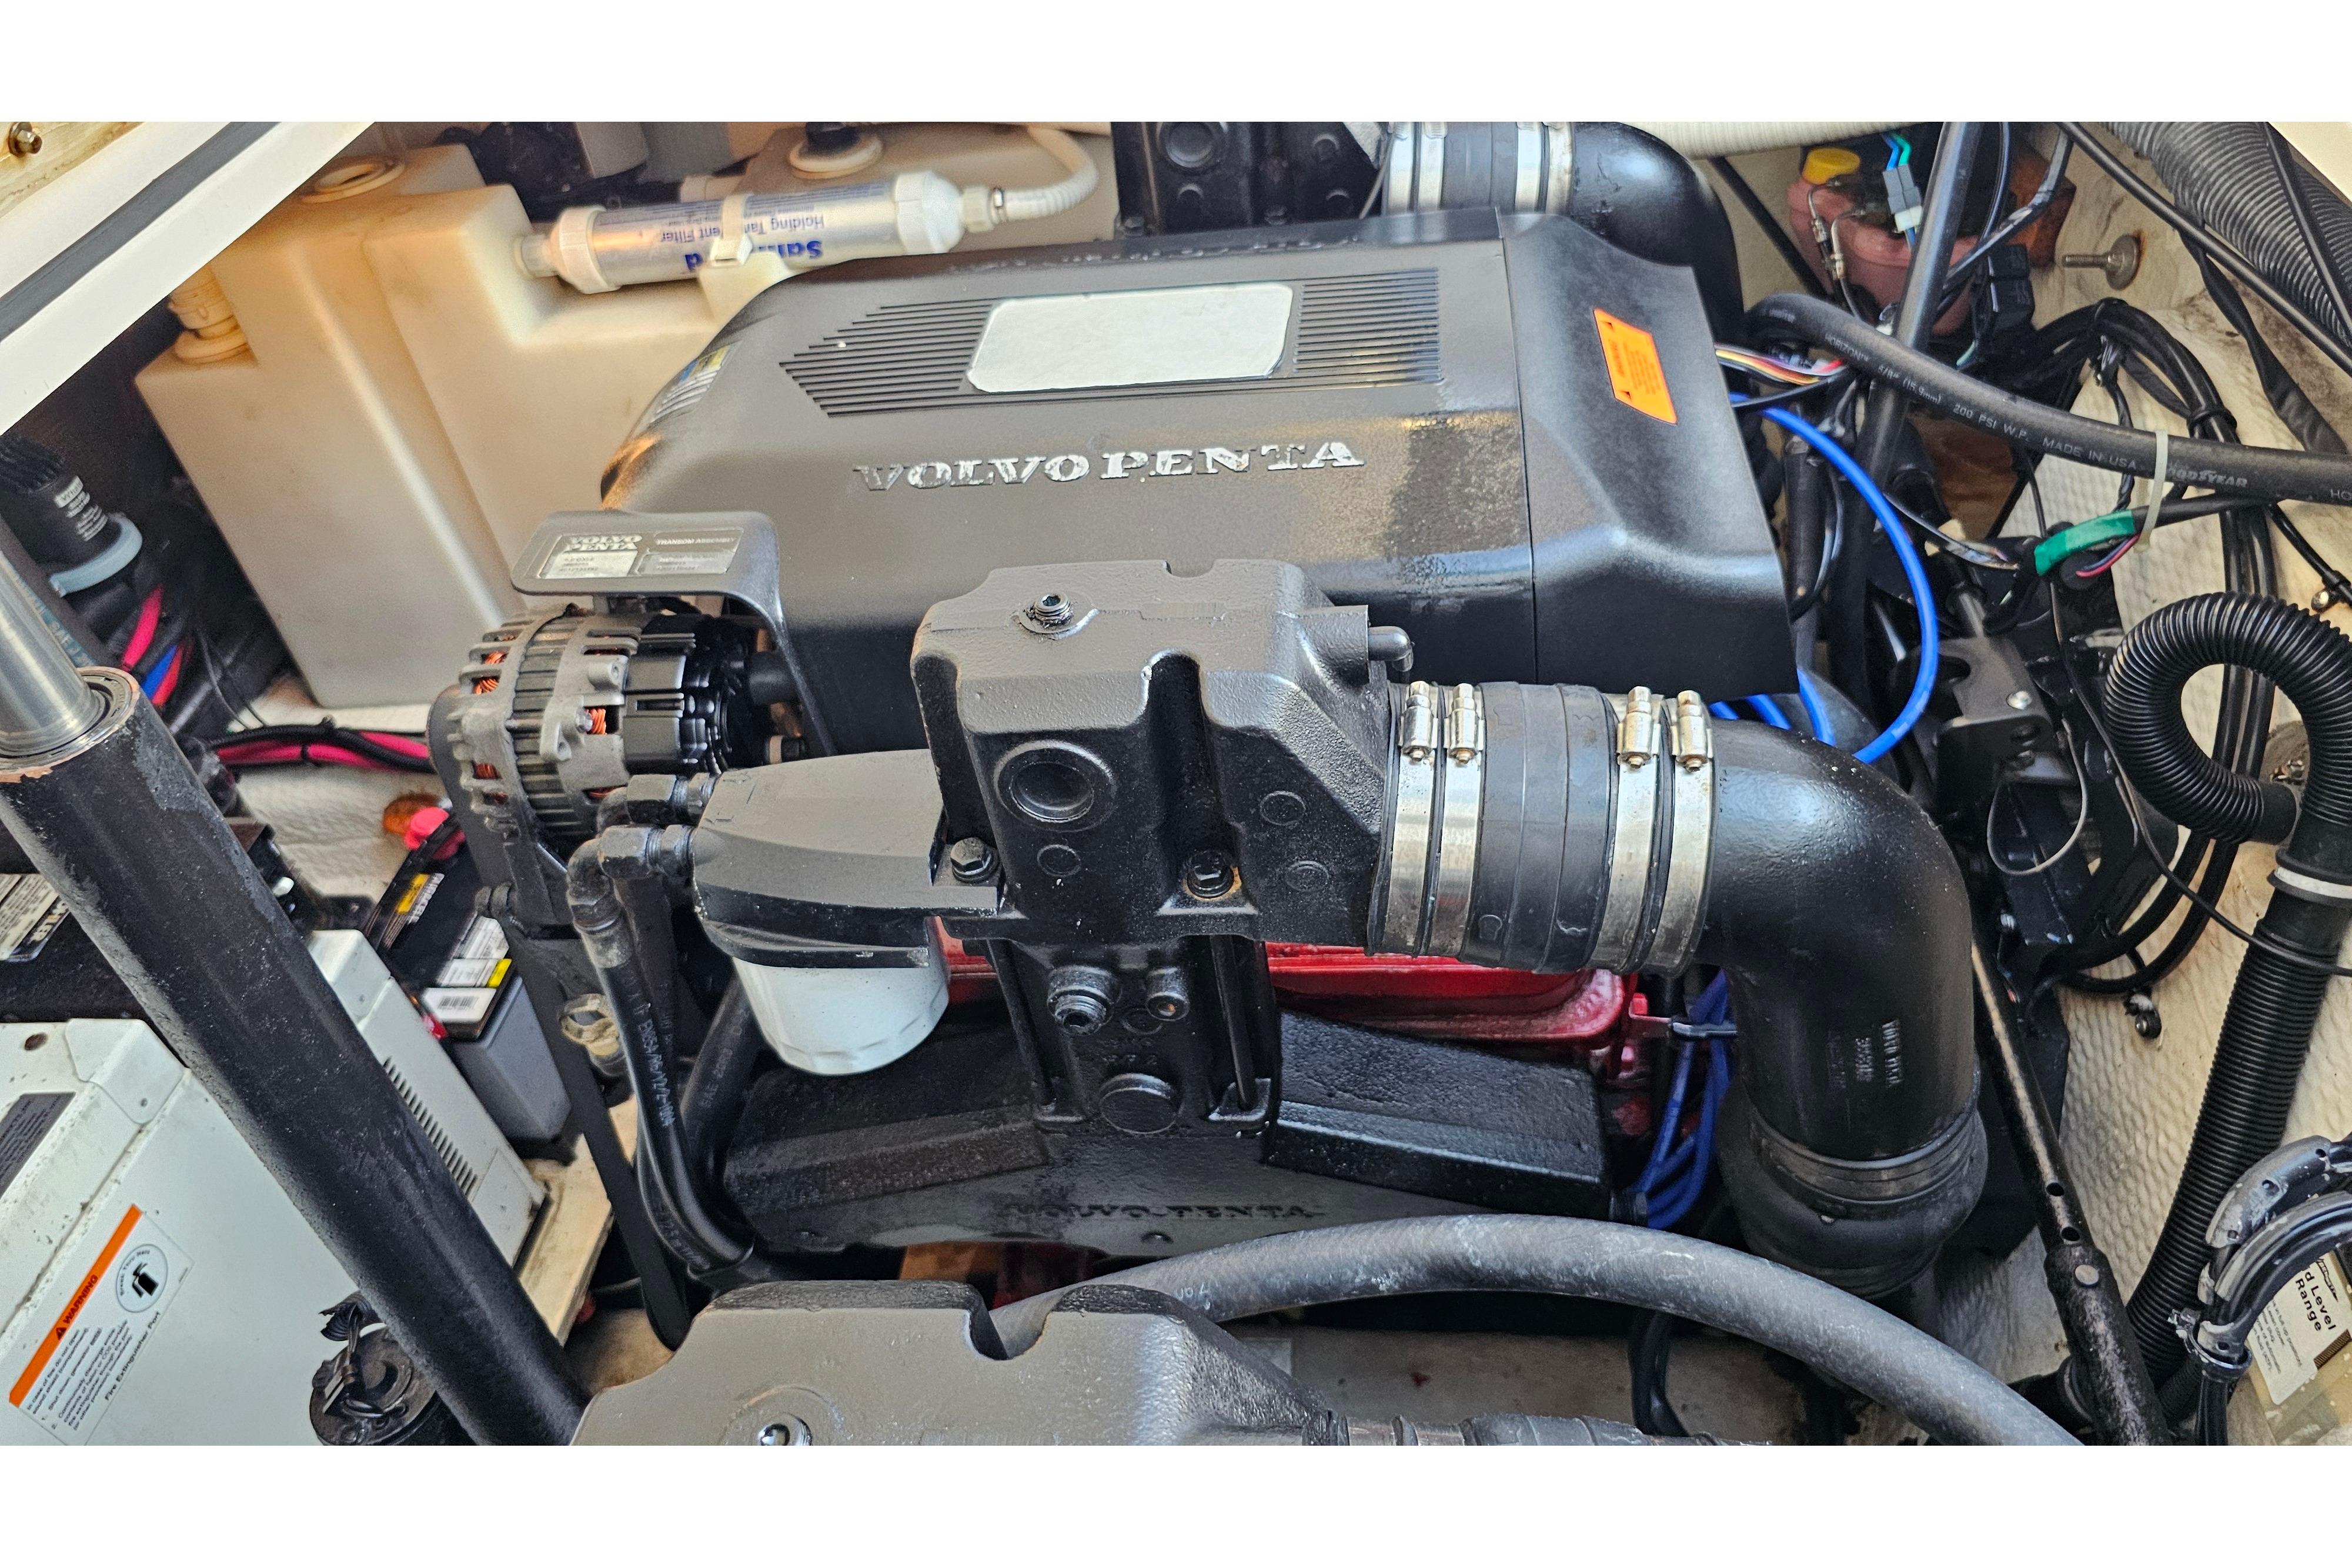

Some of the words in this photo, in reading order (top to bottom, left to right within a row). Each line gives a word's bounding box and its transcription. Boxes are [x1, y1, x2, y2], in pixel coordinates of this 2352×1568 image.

[661, 228, 696, 243] Filter
[700, 225, 723, 240] ent
[744, 220, 767, 235] Tan
[771, 214, 824, 231] Holding
[1953, 403, 1974, 419] 200
[1979, 413, 1997, 429] PSI
[2043, 437, 2085, 459] MADE
[2088, 446, 2104, 461] IN
[2107, 450, 2137, 470] USA
[854, 452, 1091, 492] VOLVO
[1099, 442, 1365, 481] PENTA
[565, 542, 639, 551] PENTA
[569, 534, 643, 544] VOLVO
[63, 1275, 98, 1323] WARNING
[2296, 1278, 2321, 1330] Range
[2311, 1286, 2336, 1330] Level
[105, 1384, 116, 1400] Fire
[116, 1332, 148, 1382] Extinguisher
[148, 1311, 160, 1329] Port
[32, 1388, 43, 1403] case
[42, 1378, 48, 1387] of
[47, 1368, 55, 1378] fire
[55, 1358, 62, 1367] do
[58, 1378, 85, 1418] Continuously
[85, 1347, 104, 1376] discharge
[76, 1378, 99, 1415] extinguisher
[48, 1395, 59, 1410] Shut
[64, 1395, 82, 1422] contents
[81, 1386, 86, 1394] of
